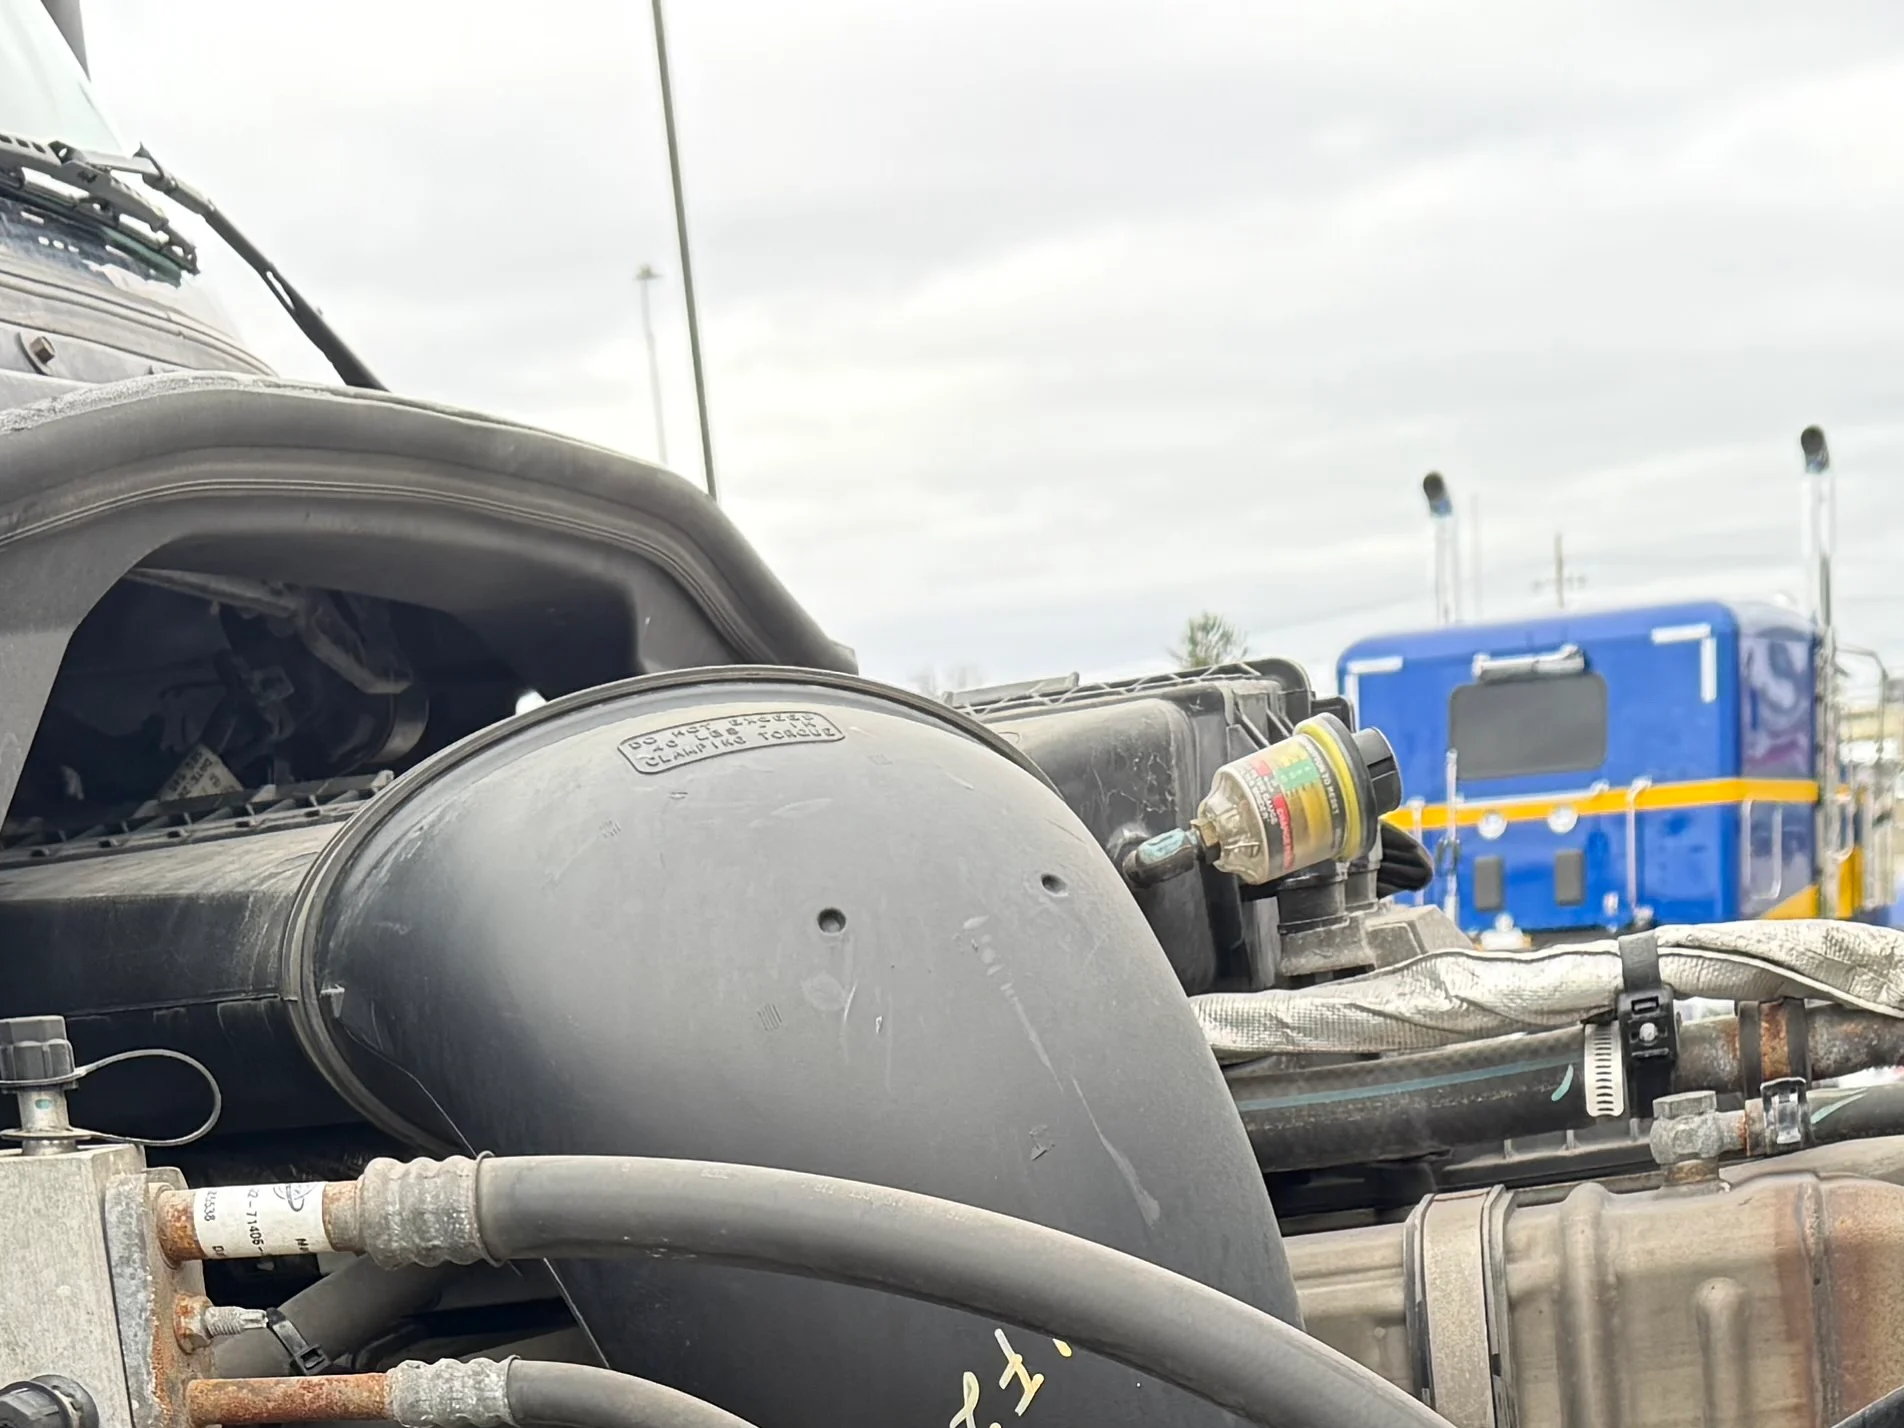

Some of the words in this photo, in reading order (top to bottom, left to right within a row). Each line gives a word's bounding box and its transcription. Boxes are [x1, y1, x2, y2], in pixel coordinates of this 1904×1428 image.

[629, 737, 657, 750] DO
[672, 723, 712, 738] NOT
[729, 714, 814, 727] EXCEED
[646, 737, 747, 767] CLAMPING
[758, 727, 836, 742] TORQUE
